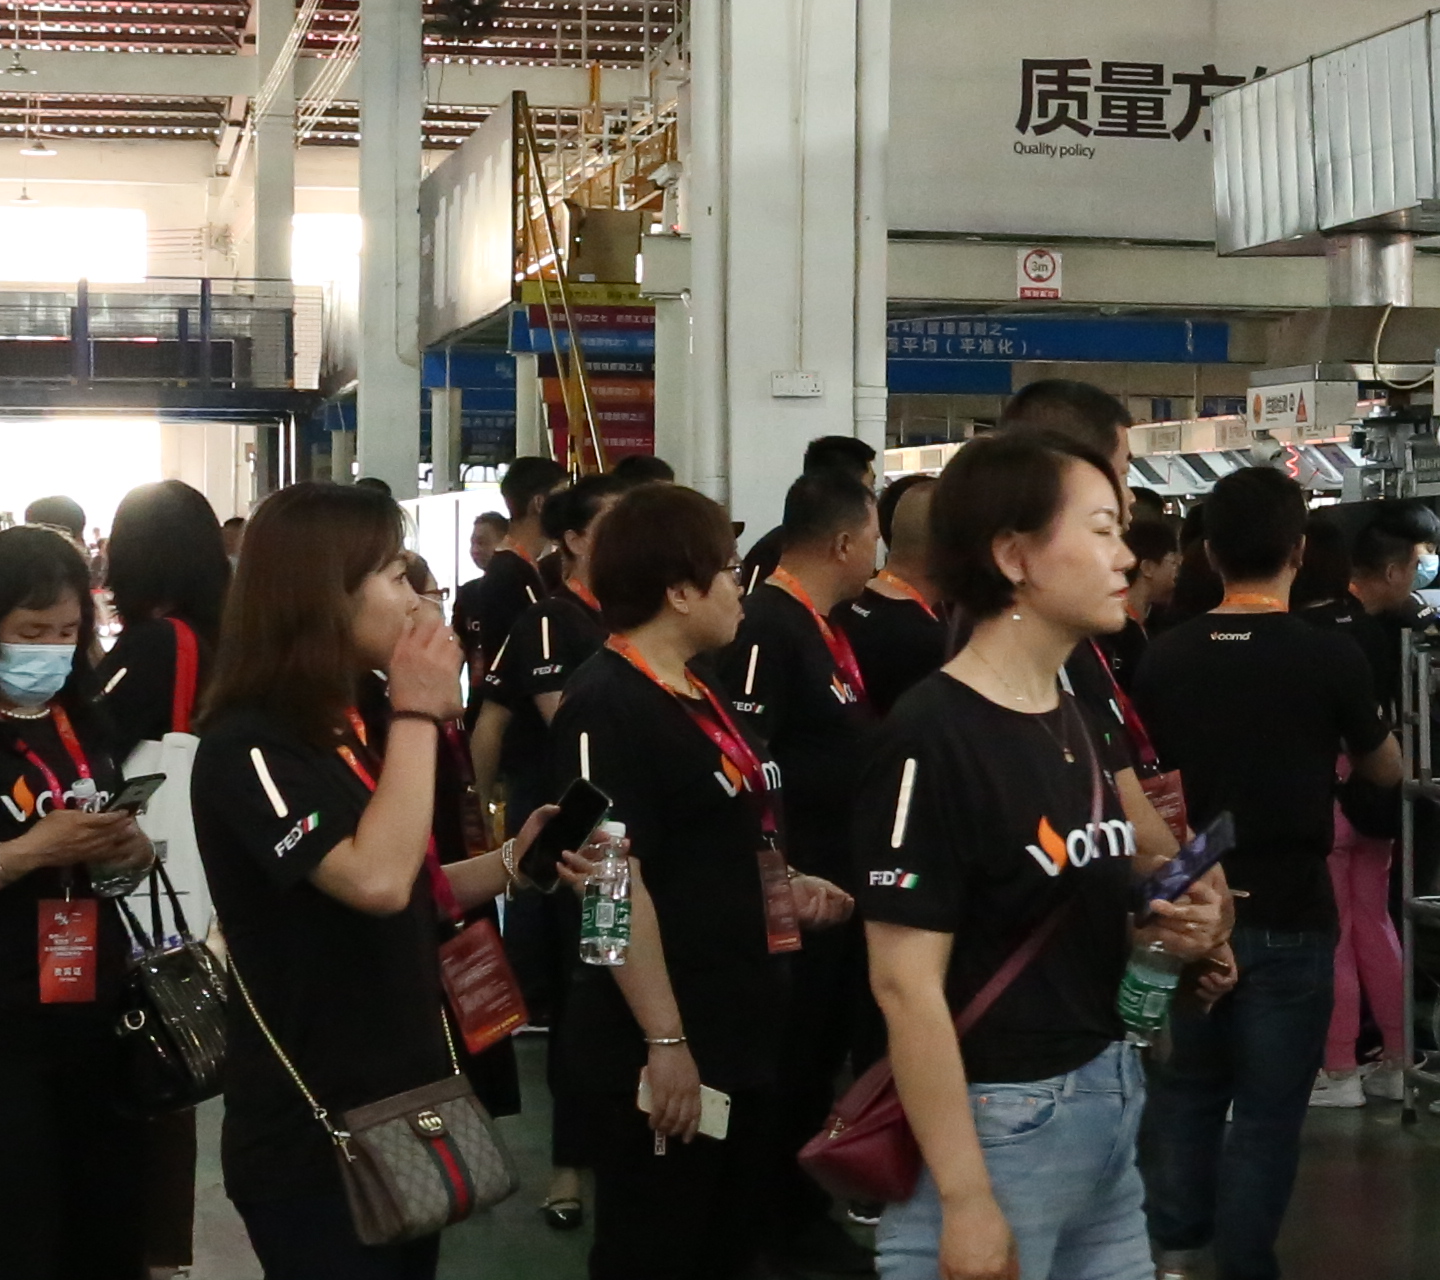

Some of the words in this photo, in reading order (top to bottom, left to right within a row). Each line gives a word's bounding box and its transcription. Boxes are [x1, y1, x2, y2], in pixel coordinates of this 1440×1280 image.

[1015, 58, 1268, 141] 质量方
[1013, 141, 1057, 157] Quality
[1060, 144, 1095, 160] policy
[1032, 261, 1048, 271] 3m
